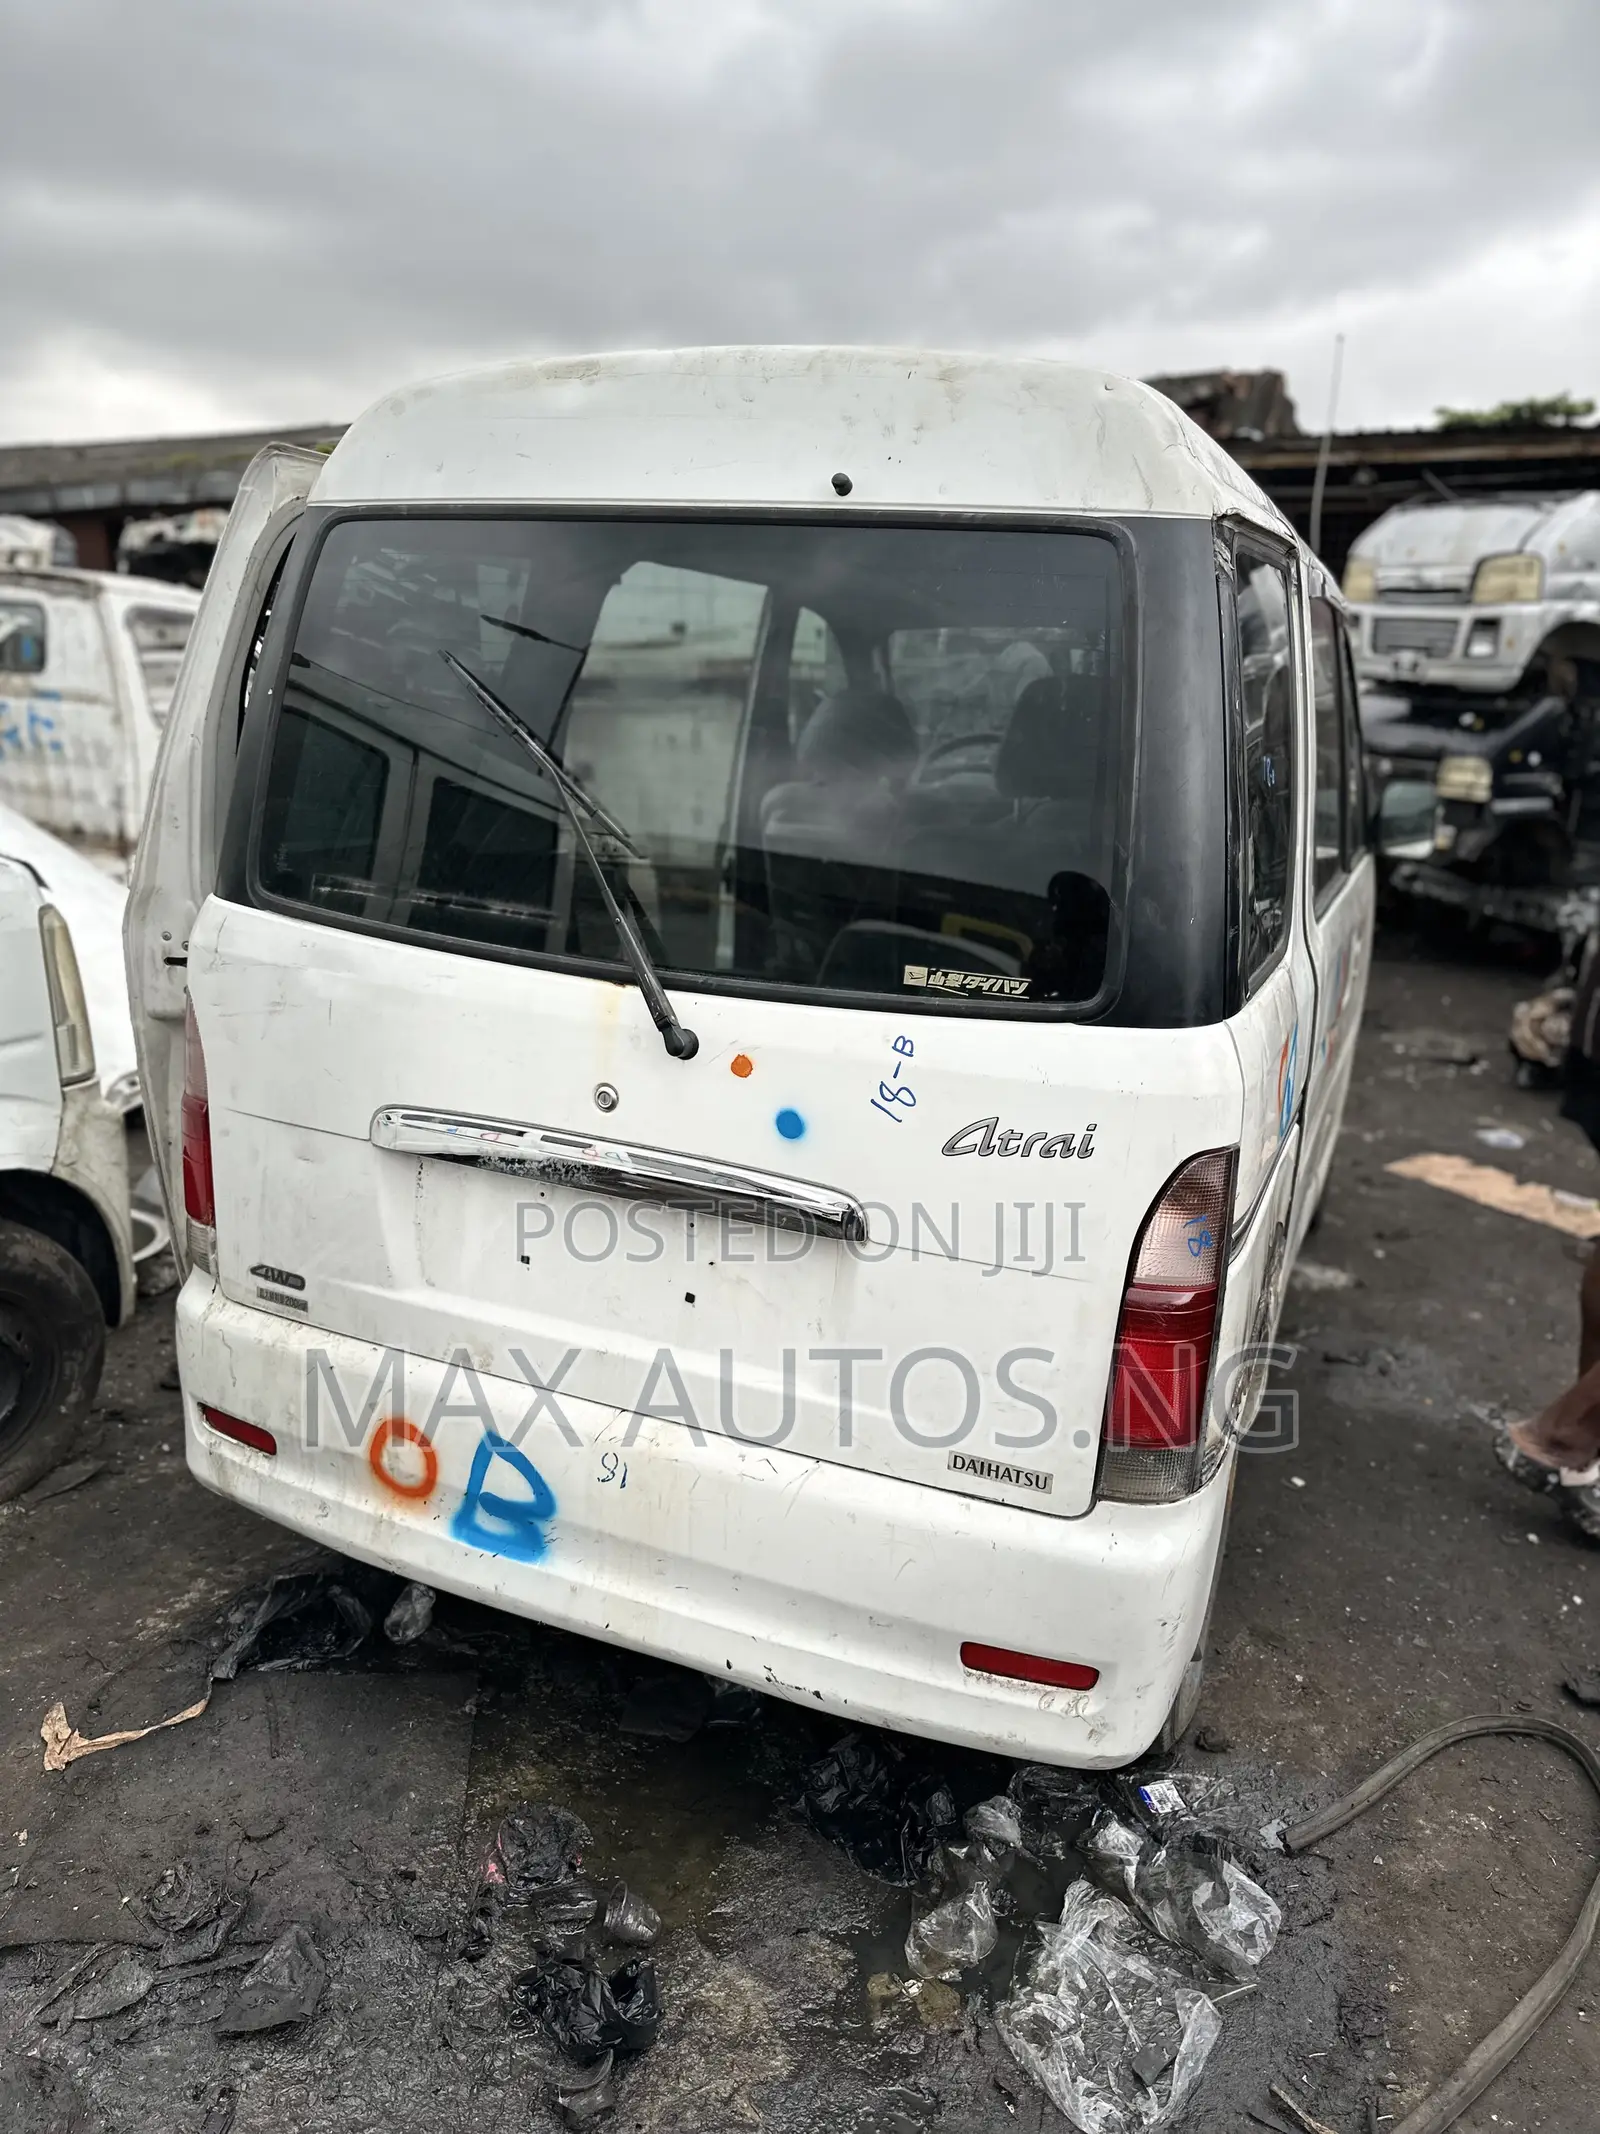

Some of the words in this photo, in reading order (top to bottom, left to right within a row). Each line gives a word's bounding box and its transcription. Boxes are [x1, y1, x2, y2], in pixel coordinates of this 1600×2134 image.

[928, 971, 1030, 995] 山梨ダイハツ
[941, 1116, 1098, 1159] Atrai
[952, 1454, 1048, 1490] DAIHATSU
